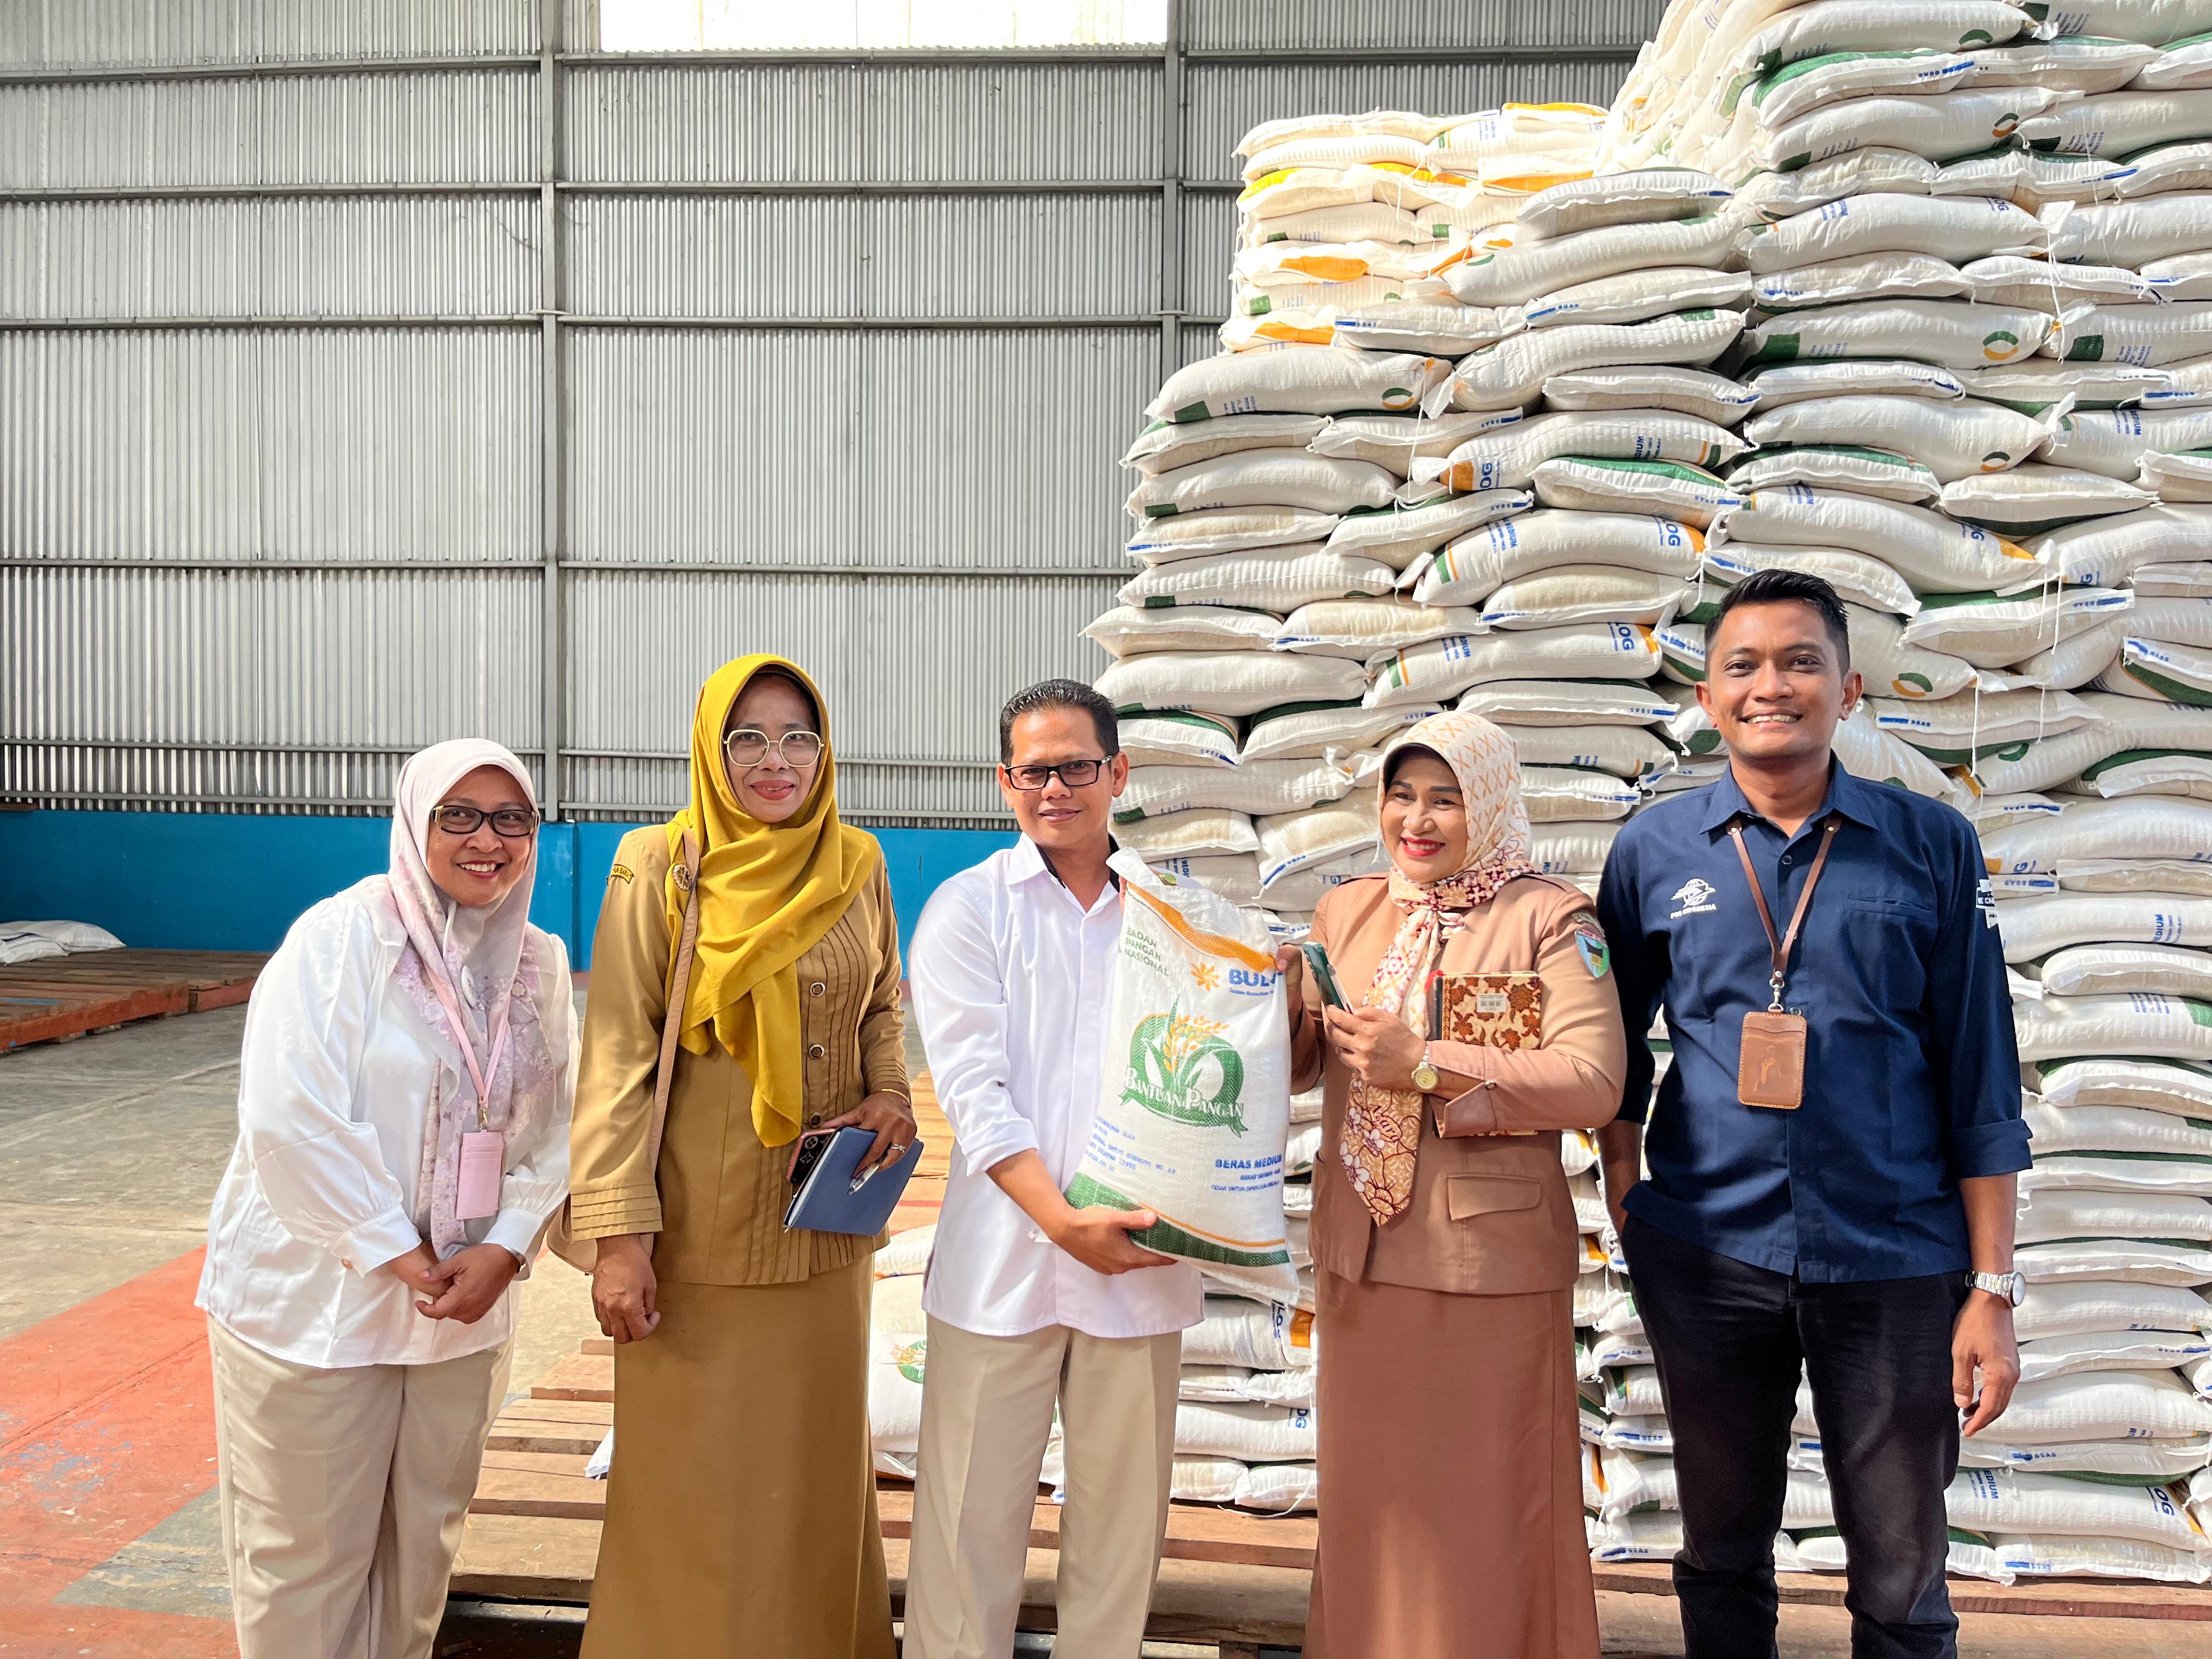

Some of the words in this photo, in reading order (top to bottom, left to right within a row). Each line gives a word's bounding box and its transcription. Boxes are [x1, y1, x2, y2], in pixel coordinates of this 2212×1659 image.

[1126, 938, 1161, 962] PANGAN
[1127, 927, 1157, 949] BADAN
[1124, 947, 1169, 977] NASIONAL
[1124, 1066, 1181, 1108] BANTUAN
